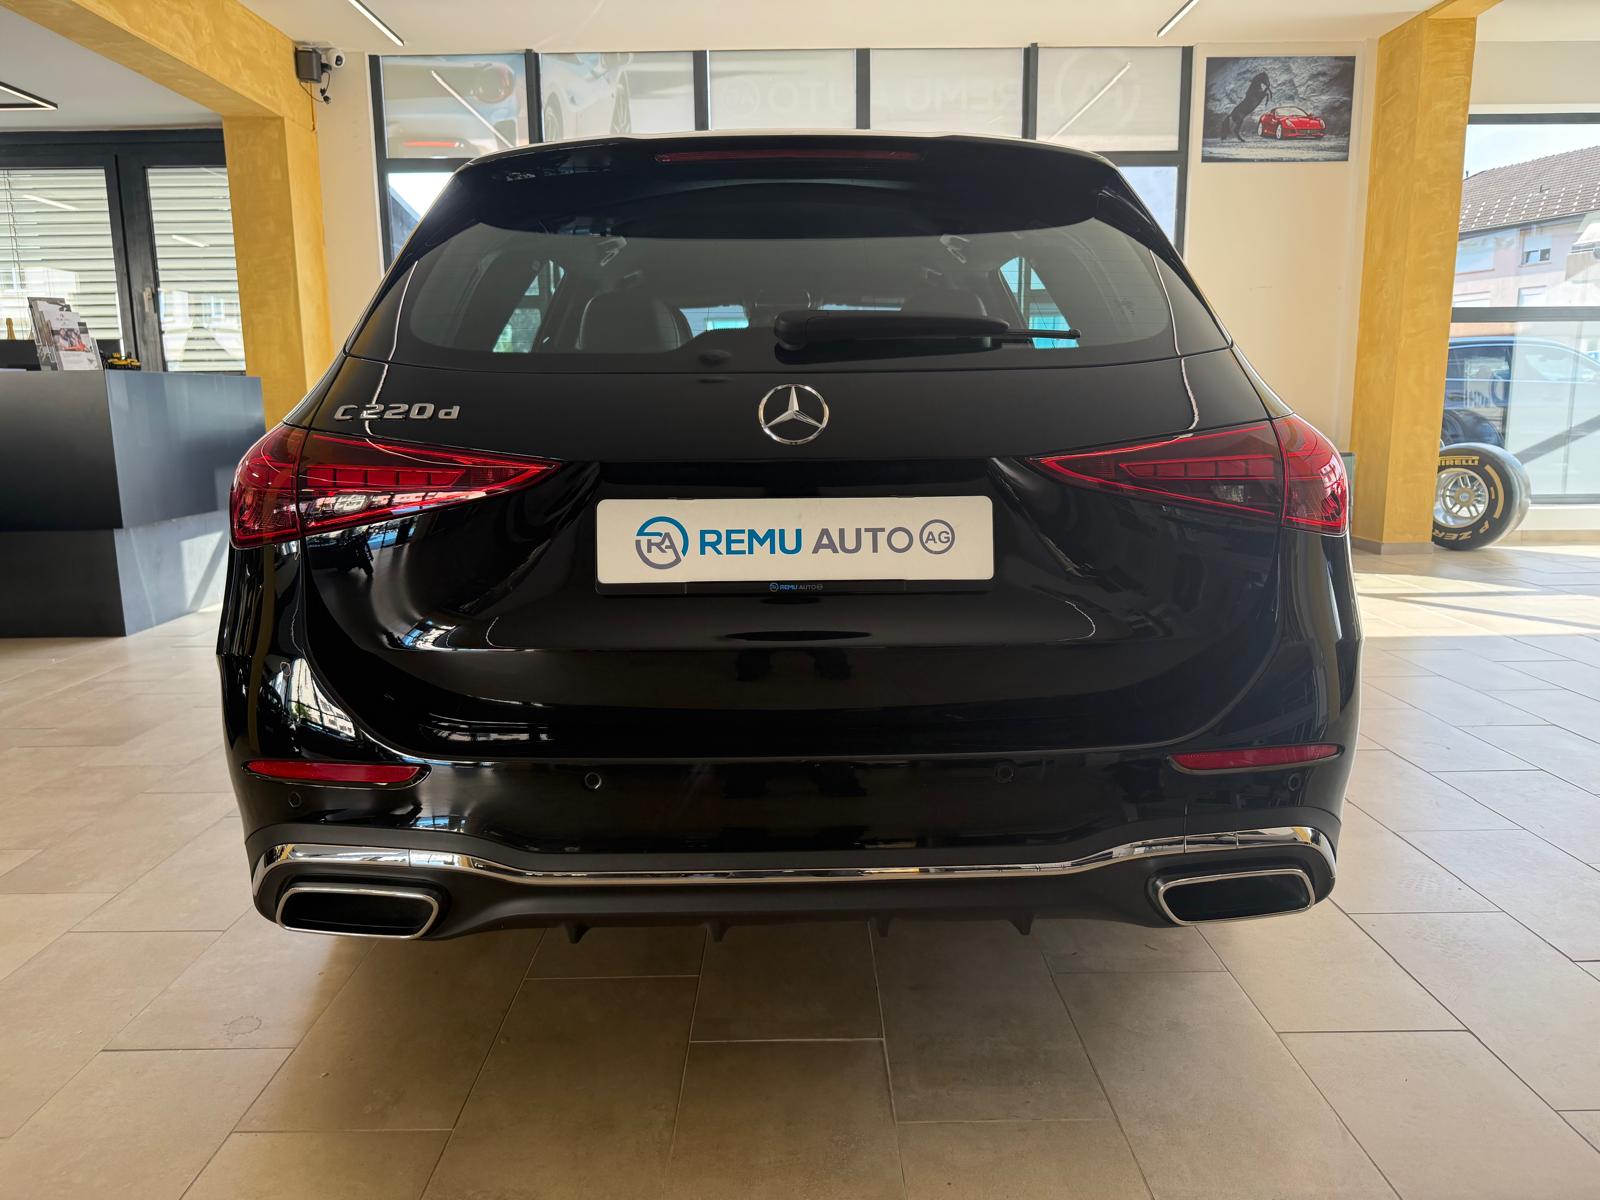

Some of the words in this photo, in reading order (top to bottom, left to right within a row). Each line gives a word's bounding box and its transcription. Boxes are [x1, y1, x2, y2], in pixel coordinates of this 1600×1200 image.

[334, 404, 358, 420] C
[1438, 455, 1479, 466] IRELLI
[699, 528, 802, 555] REMU
[812, 527, 914, 554] AUTO
[924, 530, 951, 544] AG
